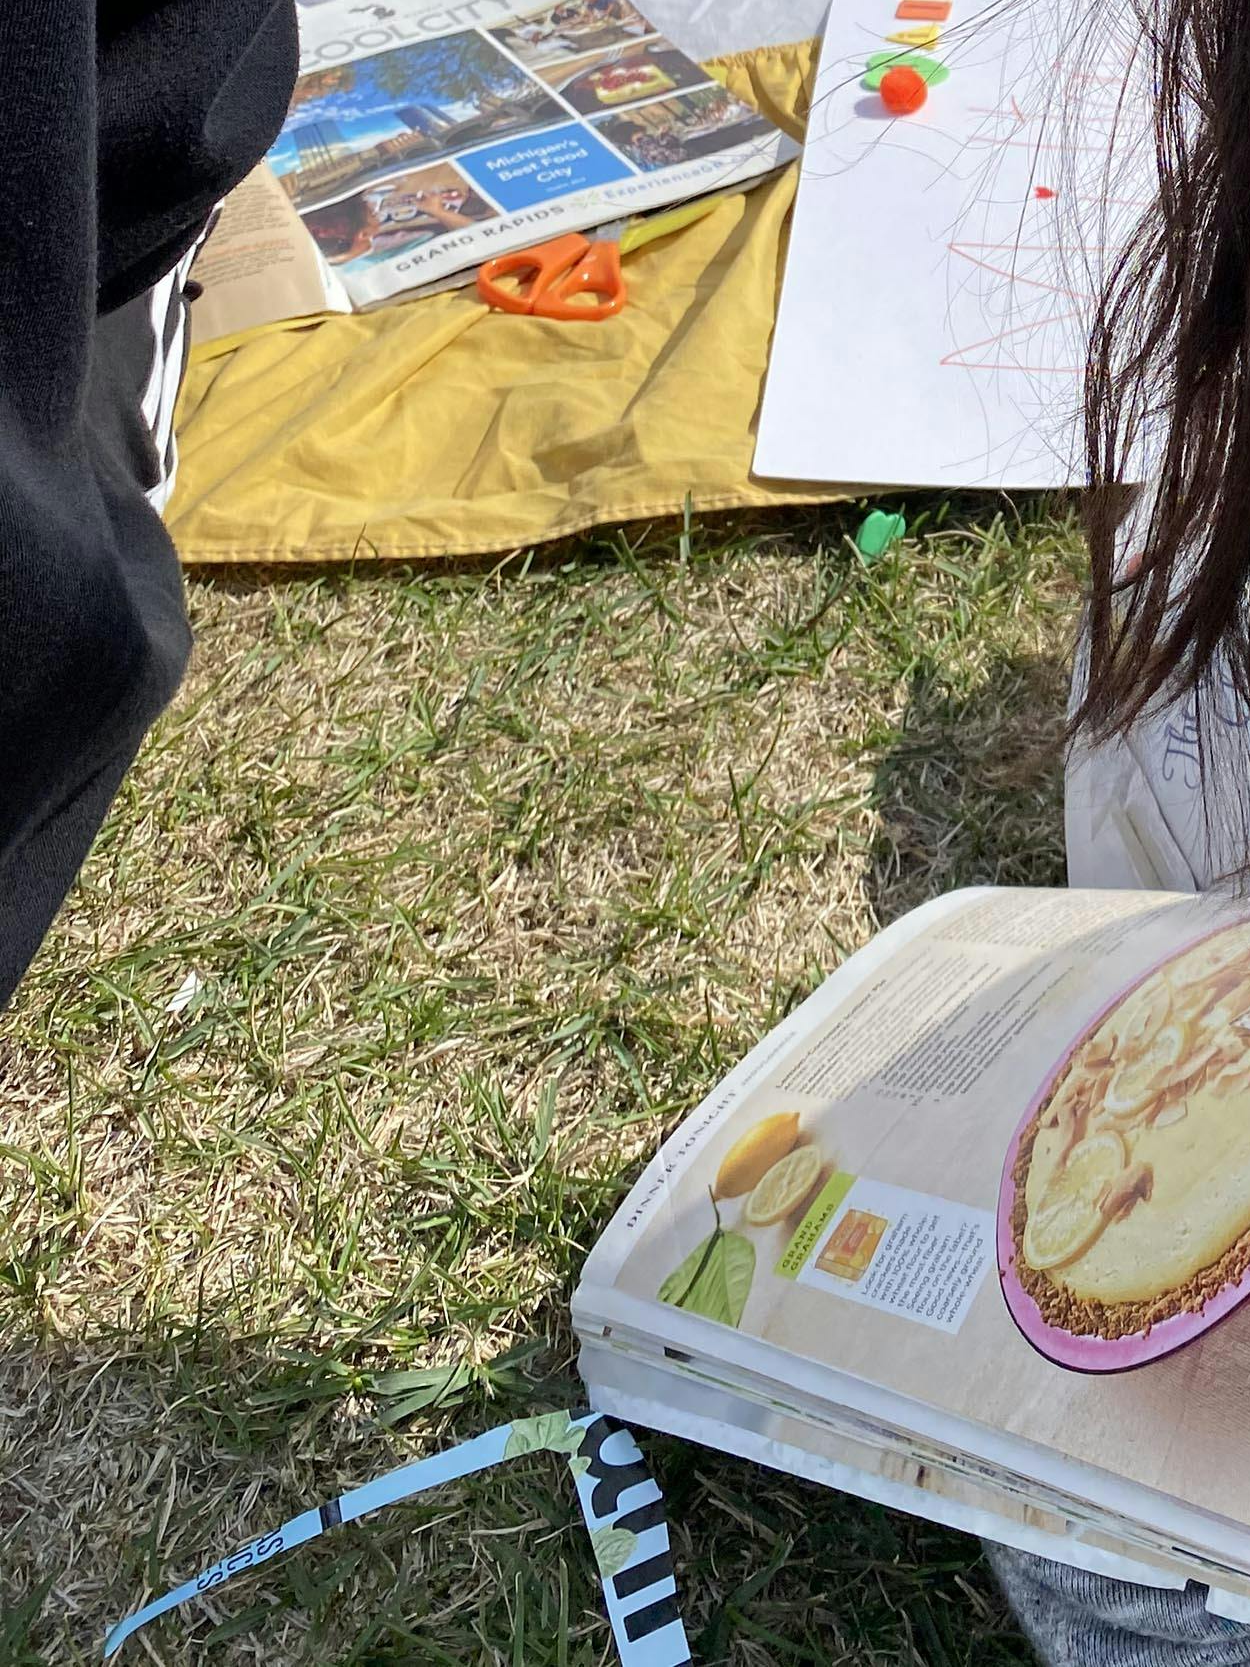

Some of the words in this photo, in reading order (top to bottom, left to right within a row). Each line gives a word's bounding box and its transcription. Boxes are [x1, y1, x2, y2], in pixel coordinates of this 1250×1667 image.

[486, 139, 579, 170] Michigan's
[498, 162, 537, 182] Best
[541, 148, 589, 166] Food
[536, 167, 572, 182] City
[396, 236, 474, 272] GRAND
[482, 205, 565, 238] RAPIDS
[627, 1163, 678, 1228] DINNER
[676, 1090, 736, 1156] TONIGHT
[782, 1220, 813, 1268] GRAND
[791, 1203, 833, 1271] GRAHAMS
[870, 1256, 894, 1297] crackers
[894, 1225, 911, 1253] made
[875, 1253, 886, 1267] for
[885, 1213, 907, 1250] graham
[889, 1272, 907, 1303] wheat
[906, 1247, 921, 1269] flour
[919, 1233, 929, 1244] to
[927, 1214, 940, 1231] get
[878, 1278, 894, 1300] with
[893, 1248, 909, 1275] 100%
[897, 1290, 909, 1306] the
[907, 1262, 924, 1287] most
[907, 1275, 929, 1310] Seeing
[927, 1234, 951, 1273] graham
[916, 1289, 932, 1313] flour
[931, 1274, 941, 1286] on
[938, 1254, 951, 1270] the
[949, 1222, 967, 1252] label?
[936, 1277, 961, 1319] coarsely
[960, 1238, 982, 1275] ground
[926, 1288, 943, 1316] Good
